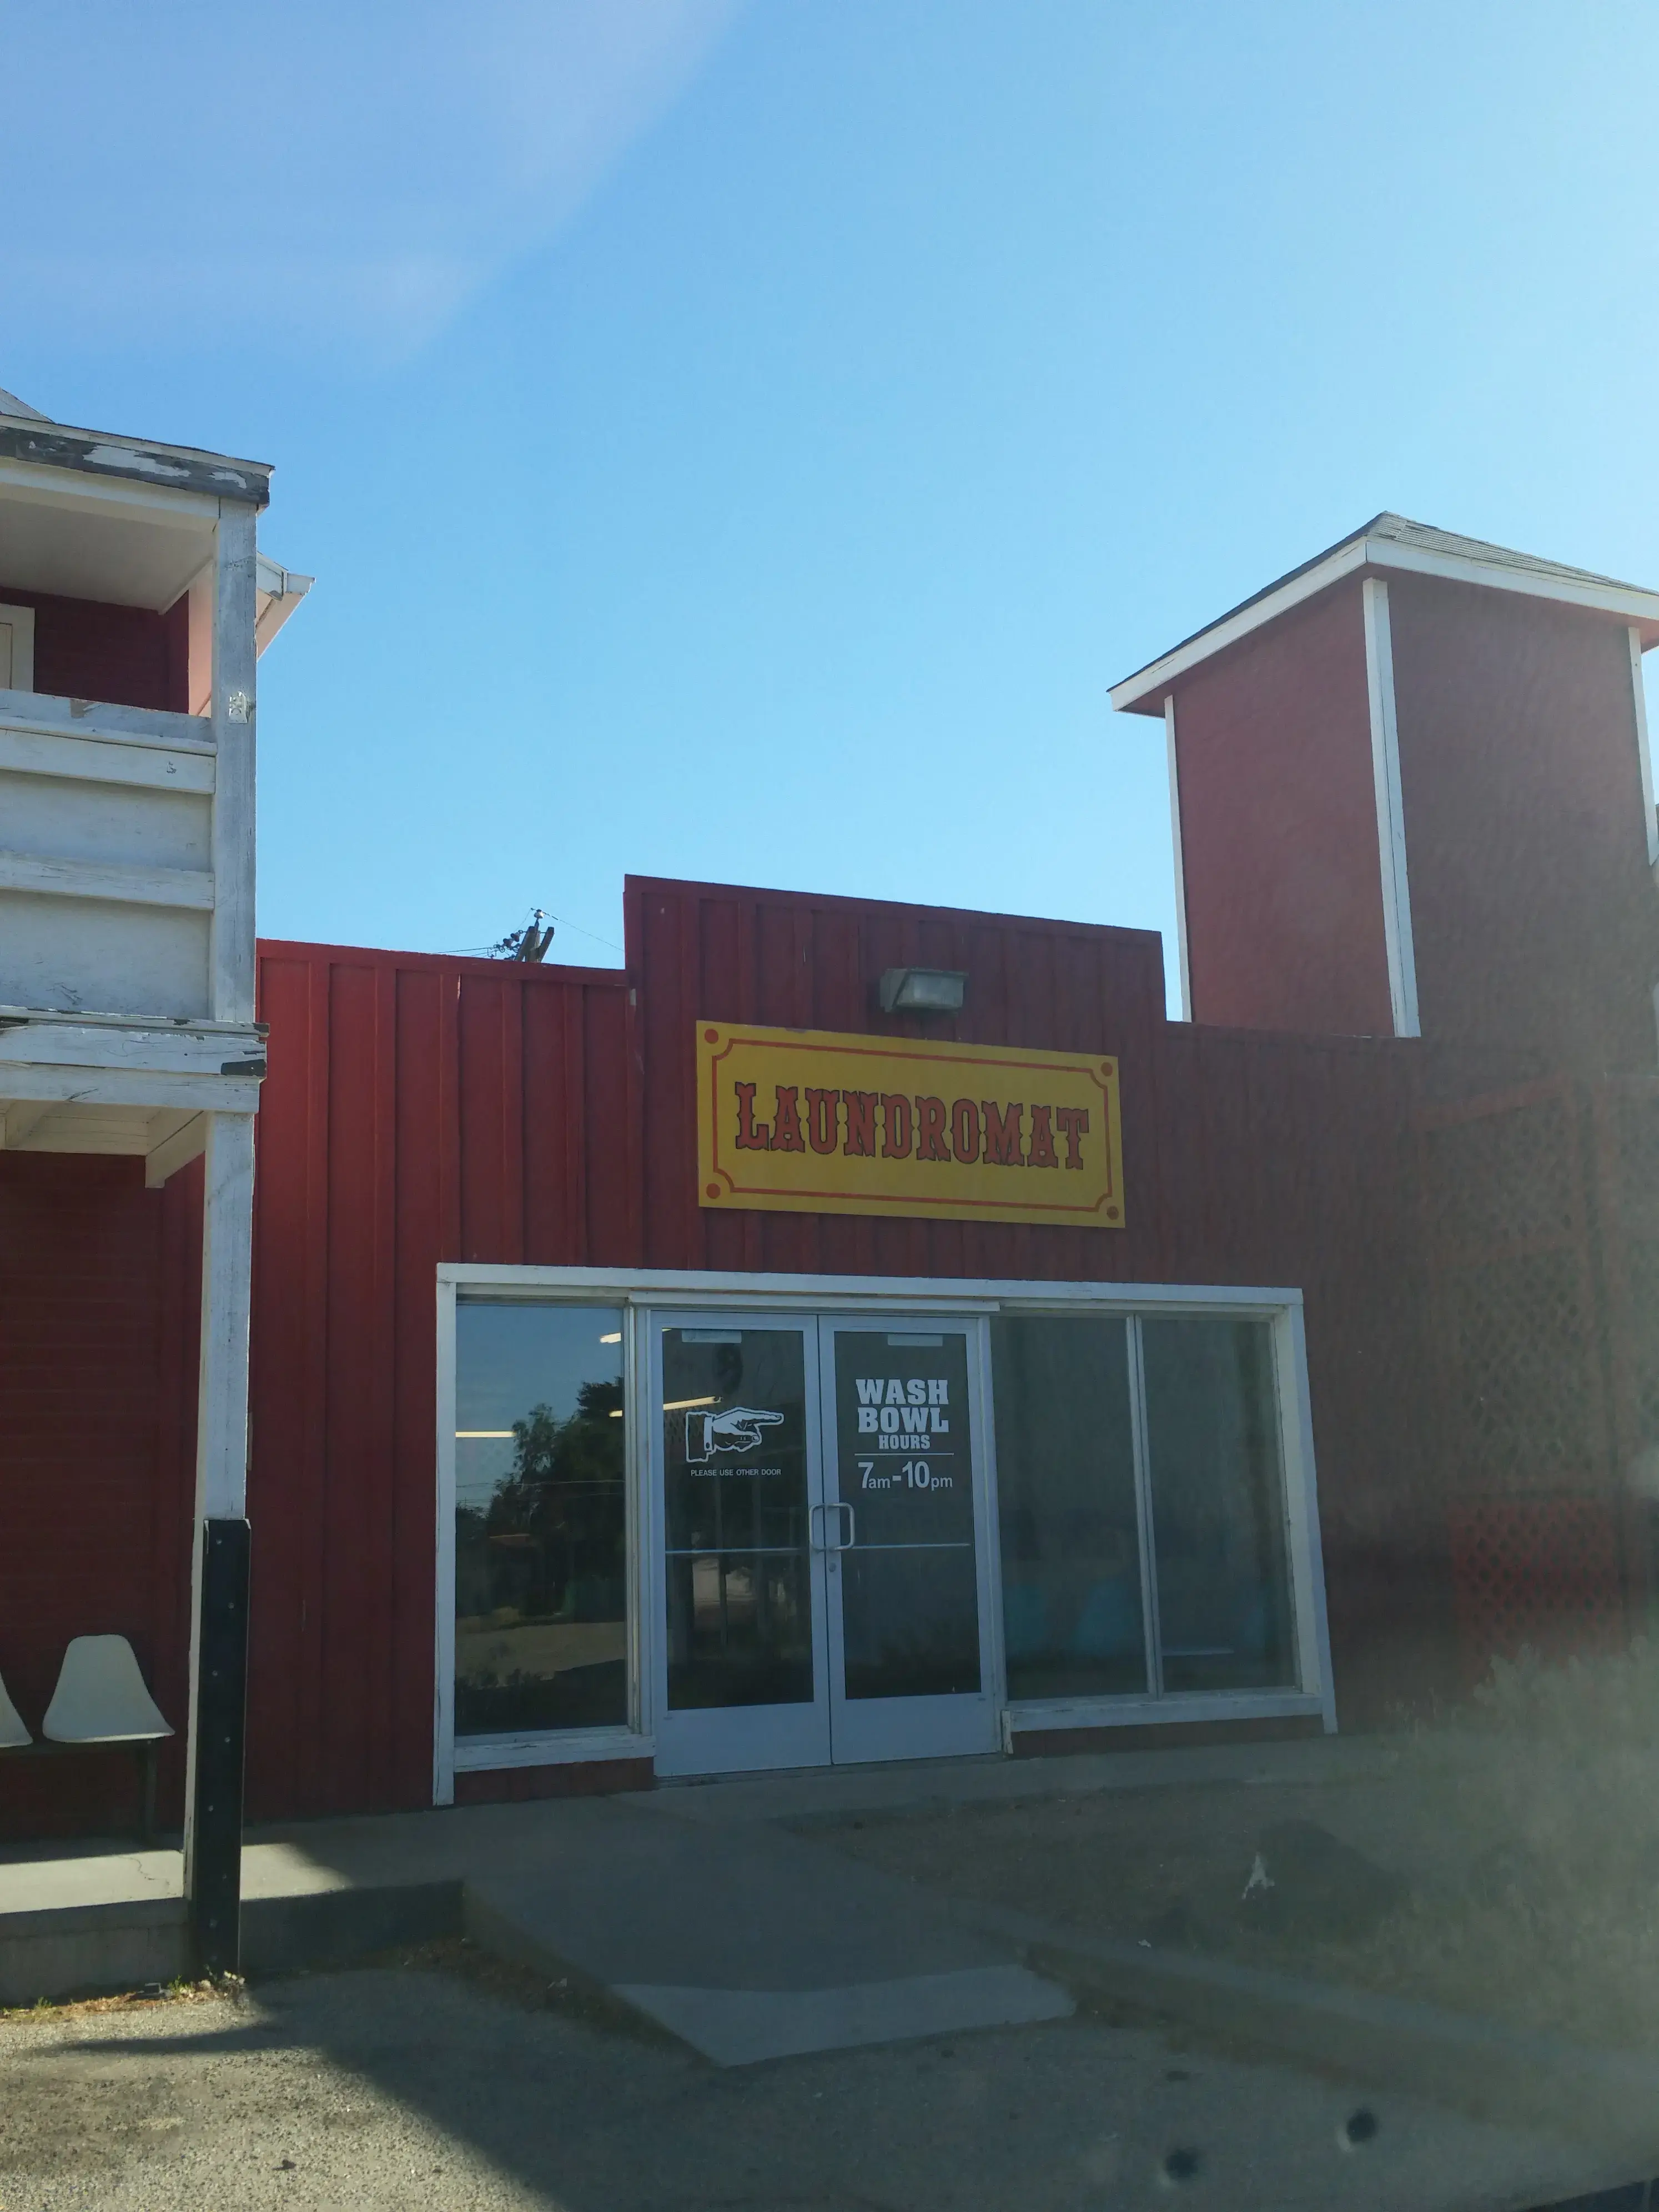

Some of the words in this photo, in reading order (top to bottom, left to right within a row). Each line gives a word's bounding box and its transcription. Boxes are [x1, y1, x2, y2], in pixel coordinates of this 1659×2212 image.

[735, 1081, 1089, 1170] LAUNDROMAT
[855, 1379, 949, 1405] WASH
[857, 1406, 949, 1433] BOWL
[878, 1434, 931, 1450] HOURS
